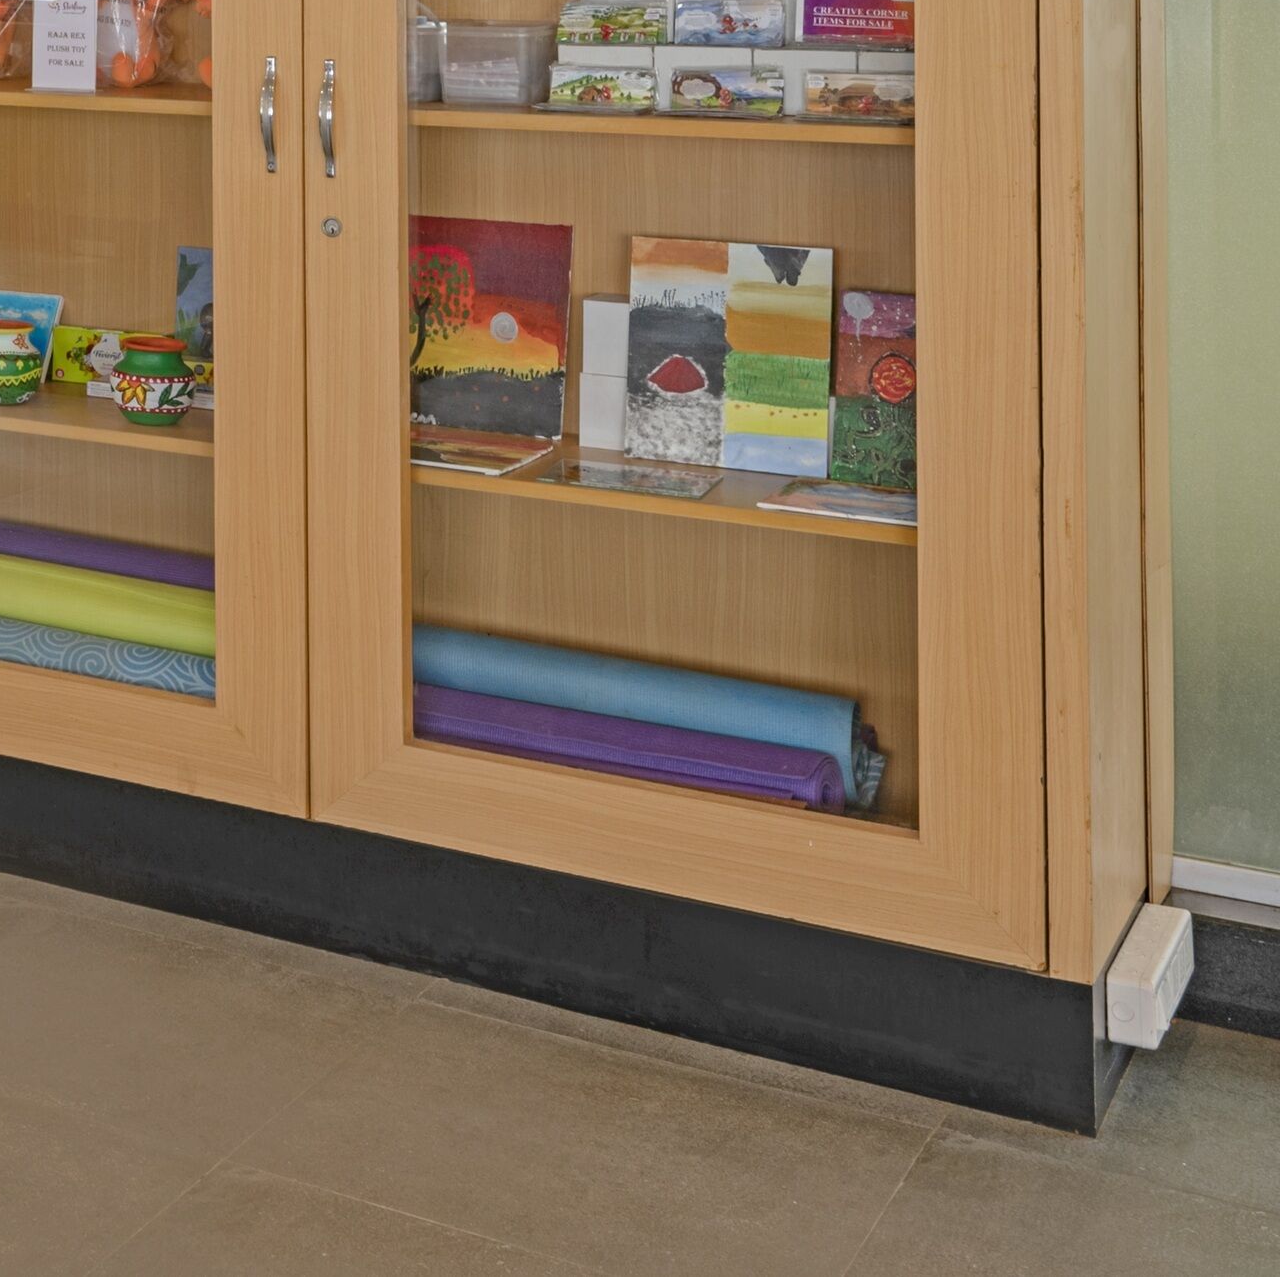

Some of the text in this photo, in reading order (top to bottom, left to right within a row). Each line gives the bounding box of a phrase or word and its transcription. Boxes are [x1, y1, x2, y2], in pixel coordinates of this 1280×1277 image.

[813, 6, 909, 18] CREATIVE CORNER
[813, 16, 894, 29] ITEMS FOR SALE
[47, 31, 86, 40] RAJA REX
[46, 45, 87, 53] PLUSH TOY
[48, 59, 63, 67] FOR
